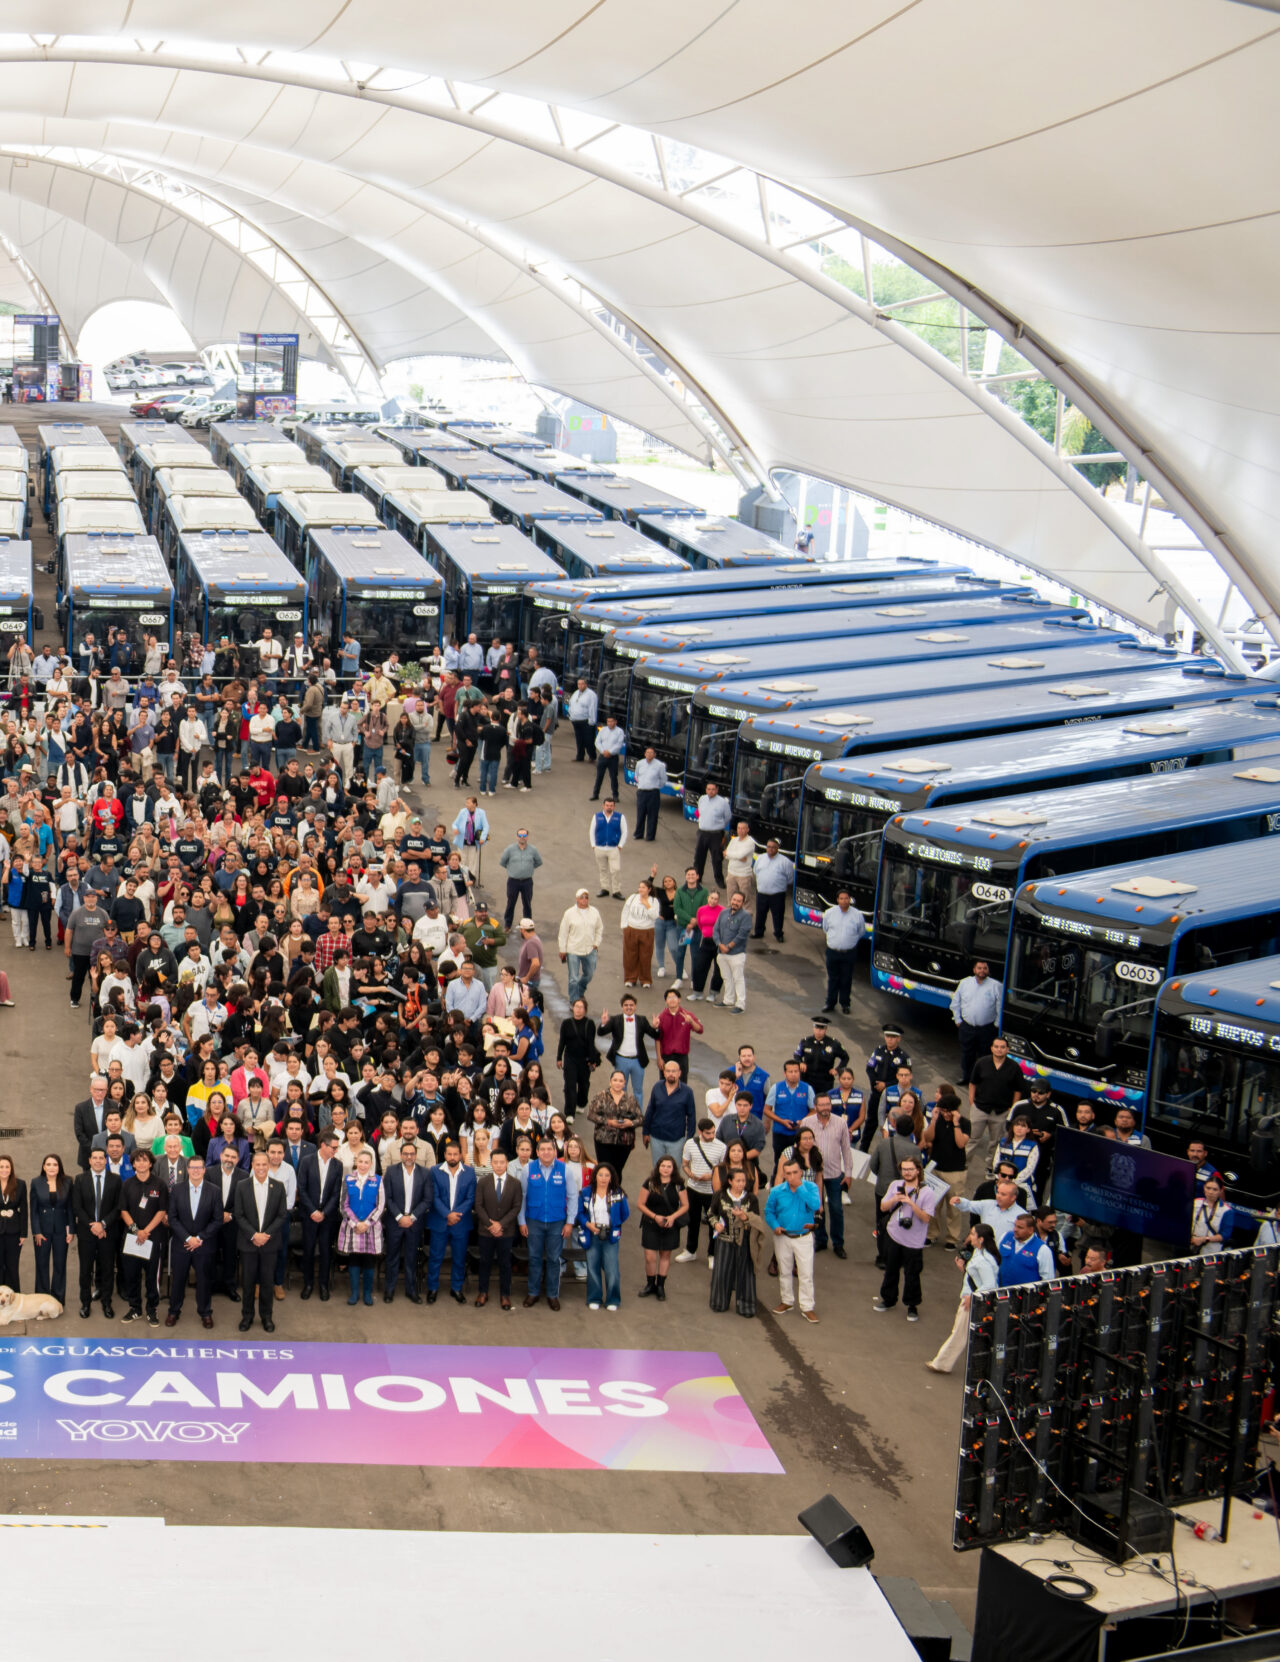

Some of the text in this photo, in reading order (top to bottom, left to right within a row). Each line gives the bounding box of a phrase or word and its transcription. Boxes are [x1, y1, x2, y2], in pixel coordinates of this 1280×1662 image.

[141, 615, 162, 624] 0667
[278, 611, 299, 620] 0626
[2, 622, 24, 630] 0649
[770, 741, 782, 753] 100
[785, 744, 811, 759] NUEVOS
[851, 792, 867, 807] 100
[869, 796, 902, 813] NUEVOS
[973, 855, 993, 872] 100
[976, 885, 1007, 901] 0648
[1104, 929, 1124, 944] 100
[1120, 963, 1156, 983] 0603
[1190, 1016, 1212, 1035] 100
[1216, 1022, 1265, 1047] NUEVOS
[21, 1345, 295, 1361] AGUASCALIENTES
[43, 1369, 670, 1418] CAMIONES
[56, 1419, 252, 1444] YOVOY
